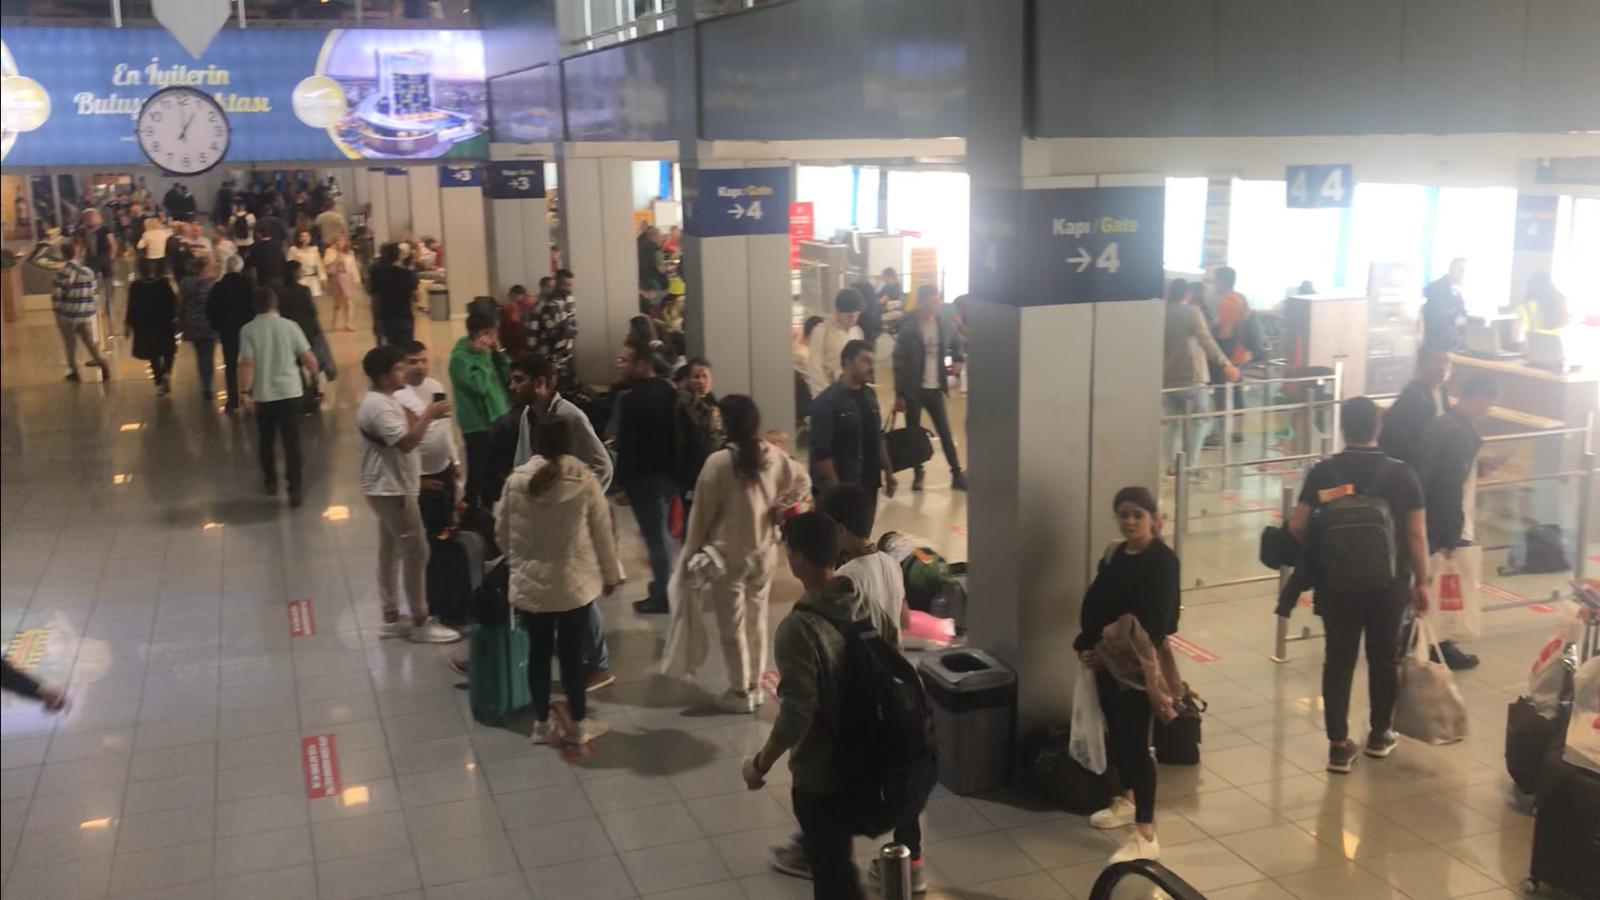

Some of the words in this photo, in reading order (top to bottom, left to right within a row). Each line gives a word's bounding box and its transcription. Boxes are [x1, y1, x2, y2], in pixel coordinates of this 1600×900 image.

[112, 63, 140, 86] En
[145, 57, 230, 89] İyilerin
[461, 169, 473, 181] 3
[517, 176, 531, 190] 3
[1319, 168, 1344, 202] 4
[746, 201, 764, 219] 4
[1052, 218, 1091, 238] Kapı
[1101, 217, 1138, 233] Gate
[1095, 241, 1120, 273] 4
